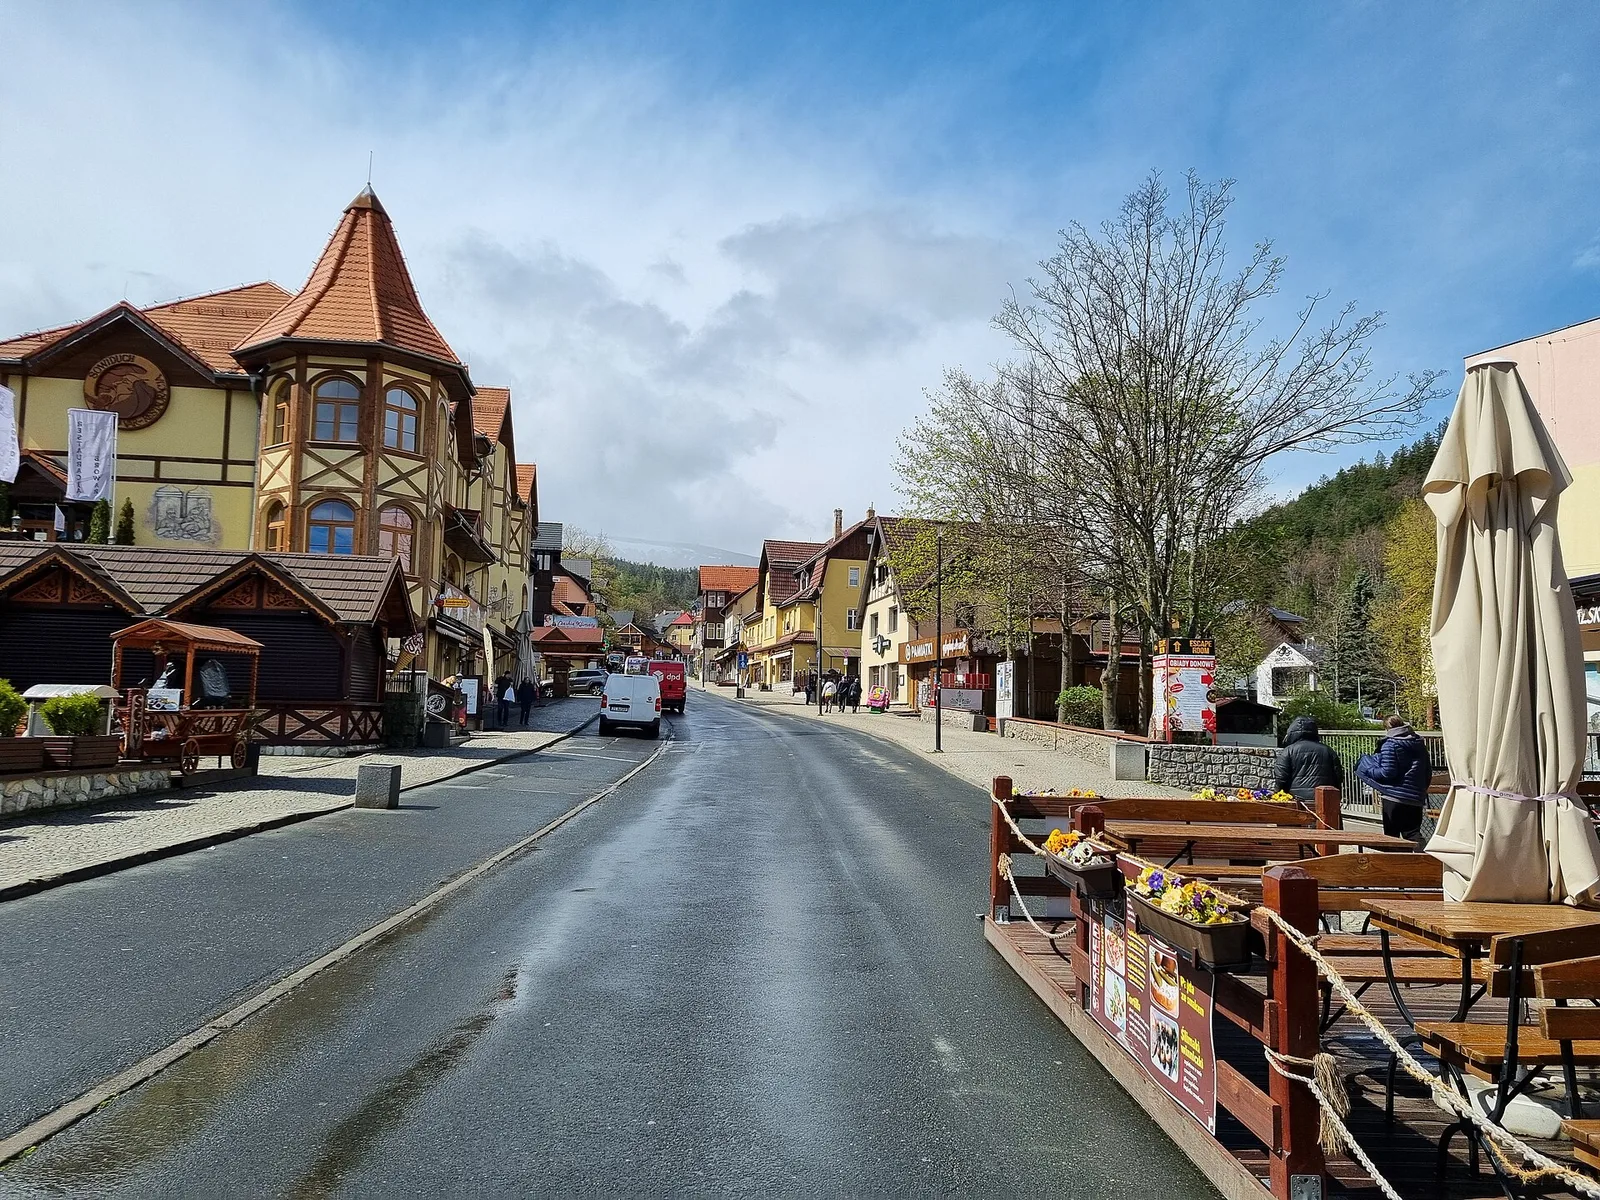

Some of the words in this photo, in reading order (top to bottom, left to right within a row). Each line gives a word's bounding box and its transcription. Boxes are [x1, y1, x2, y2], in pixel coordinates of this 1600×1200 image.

[89, 354, 136, 379] SOWIDUCH
[1189, 639, 1213, 648] ESCAPE
[1192, 646, 1210, 655] ROOM
[1169, 659, 1189, 667] OBIADY
[1190, 660, 1214, 668] DOMOWE
[666, 673, 681, 682] dpd
[1180, 975, 1195, 995] Pajda
